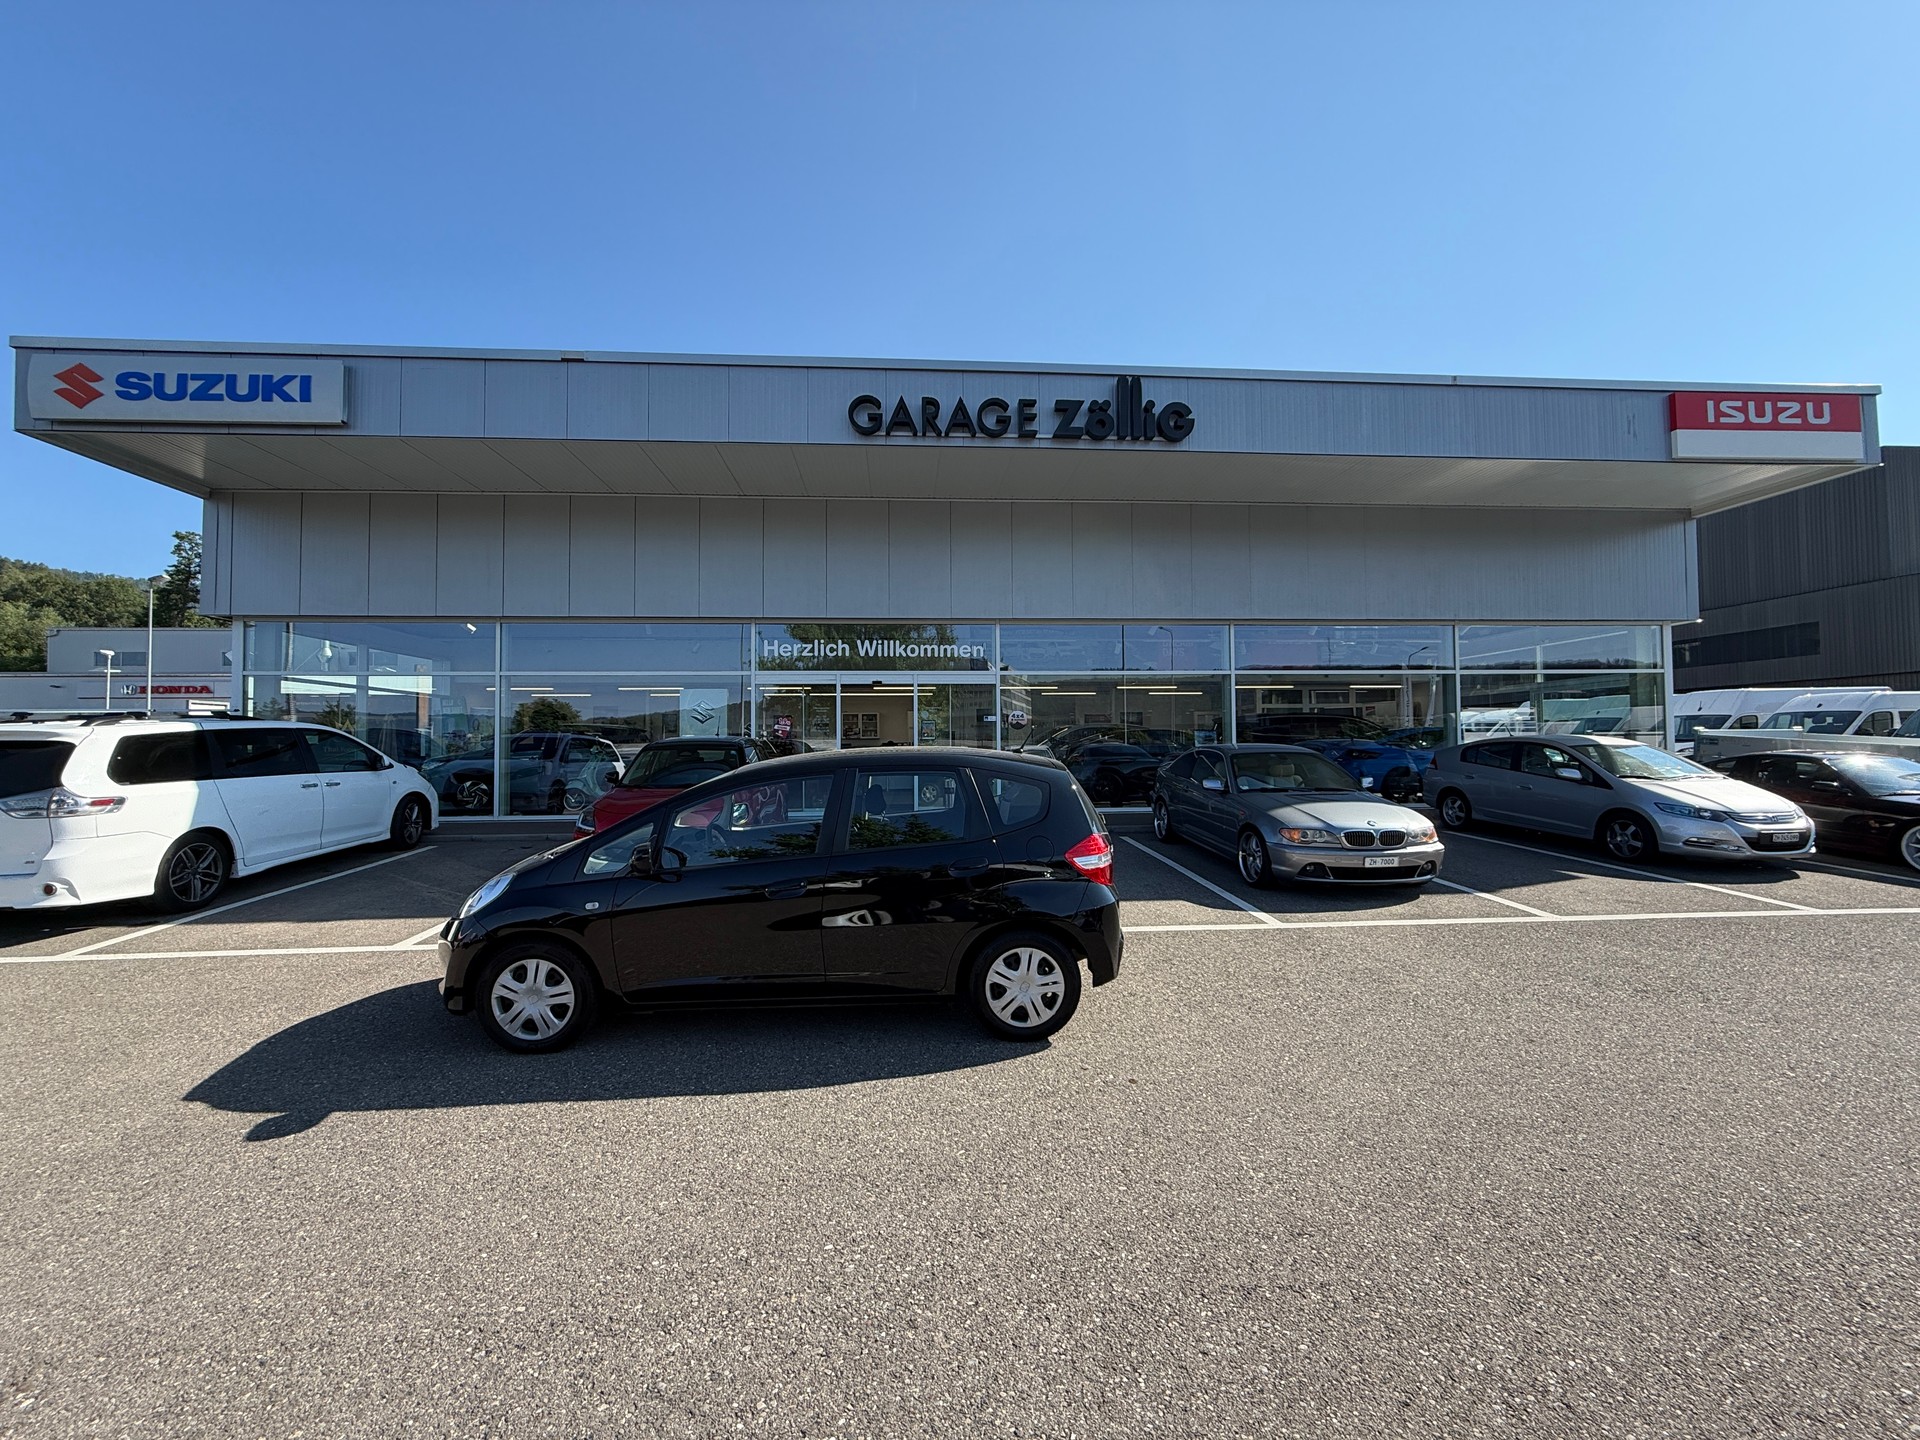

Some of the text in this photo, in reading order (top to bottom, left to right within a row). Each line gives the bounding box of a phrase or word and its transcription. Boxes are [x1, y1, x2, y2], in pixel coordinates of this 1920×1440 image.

[115, 371, 312, 402] SUZUKI
[848, 394, 1038, 438] GARAGE
[1706, 400, 1831, 424] ISUZU
[763, 639, 985, 658] Herzlich Willkommen
[139, 686, 214, 694] HONDA
